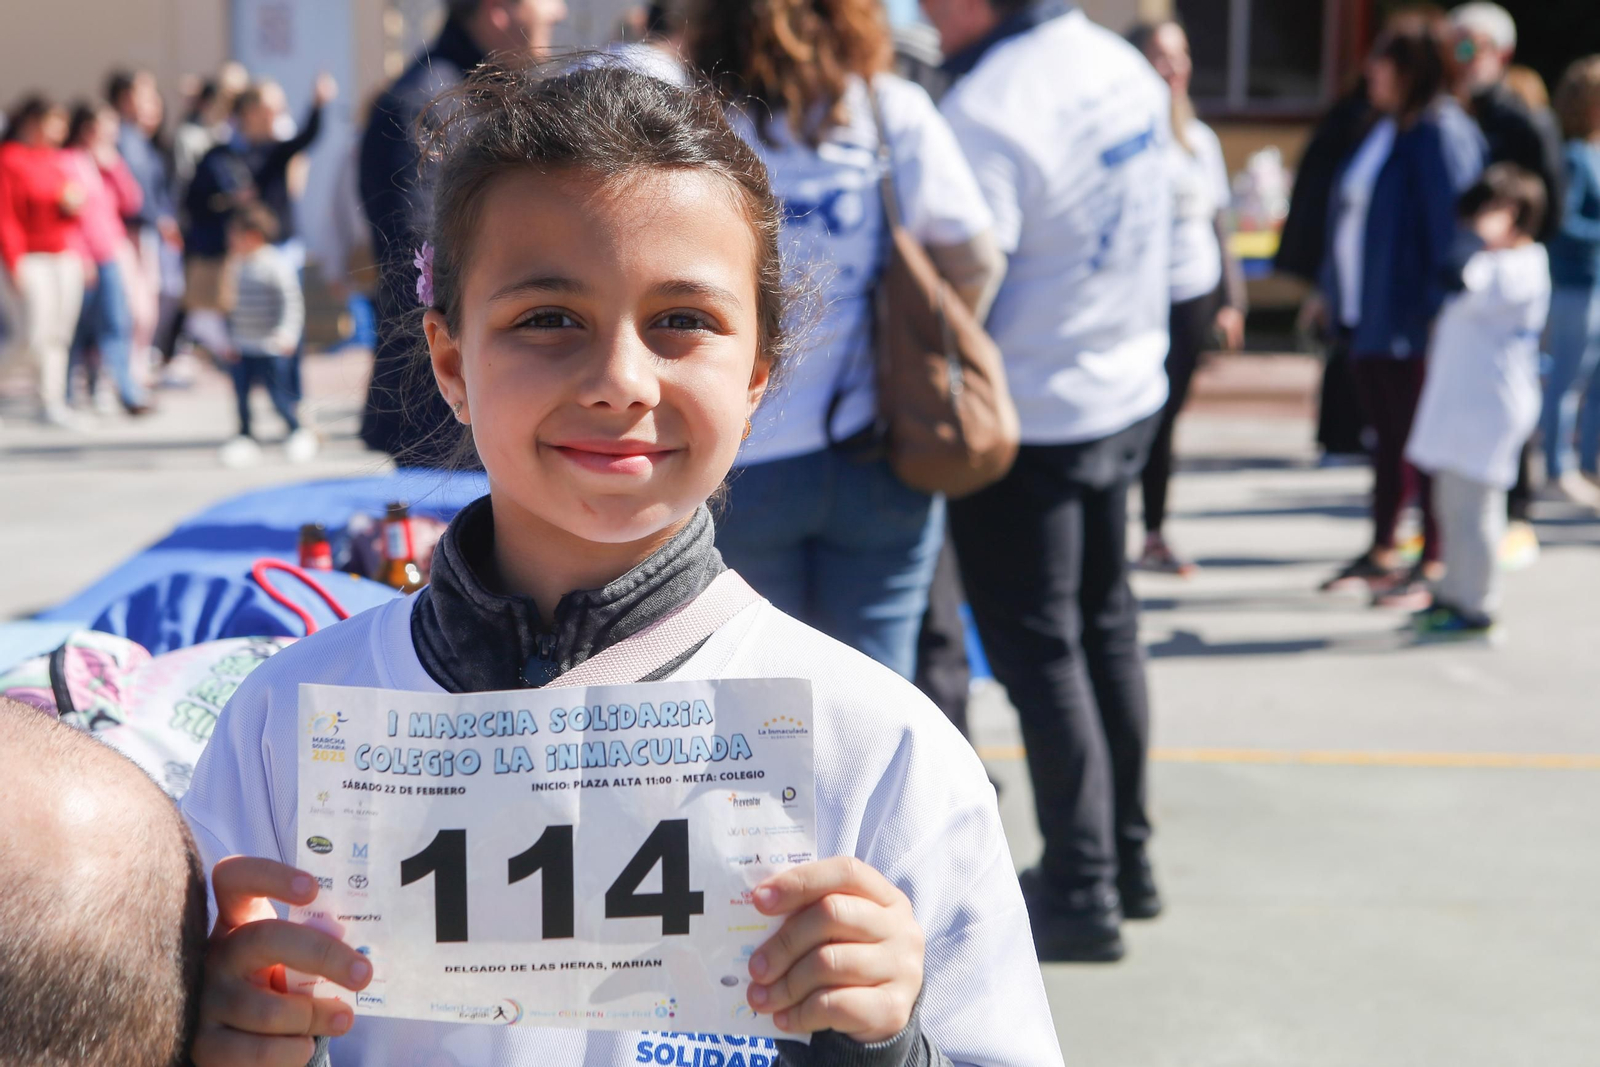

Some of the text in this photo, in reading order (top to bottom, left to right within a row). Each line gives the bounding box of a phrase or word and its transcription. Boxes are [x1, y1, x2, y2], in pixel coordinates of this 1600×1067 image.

[387, 709, 399, 737] I
[408, 709, 538, 739] MARCHA
[312, 749, 346, 762] 2025
[493, 746, 535, 774] LA
[341, 778, 467, 796] SÁBADO 22 DE FEBRERO
[531, 781, 571, 792] INICIO:
[573, 778, 610, 789] PLAZA
[613, 776, 642, 787] ALTA
[646, 775, 672, 786] 11:00
[682, 773, 717, 784] META:
[719, 770, 765, 781] COLEGIO
[401, 818, 704, 943] 114
[445, 959, 662, 974] DELGADO DE LAS HERAS, MARIAN
[636, 1041, 777, 1067] SOLIDAR
